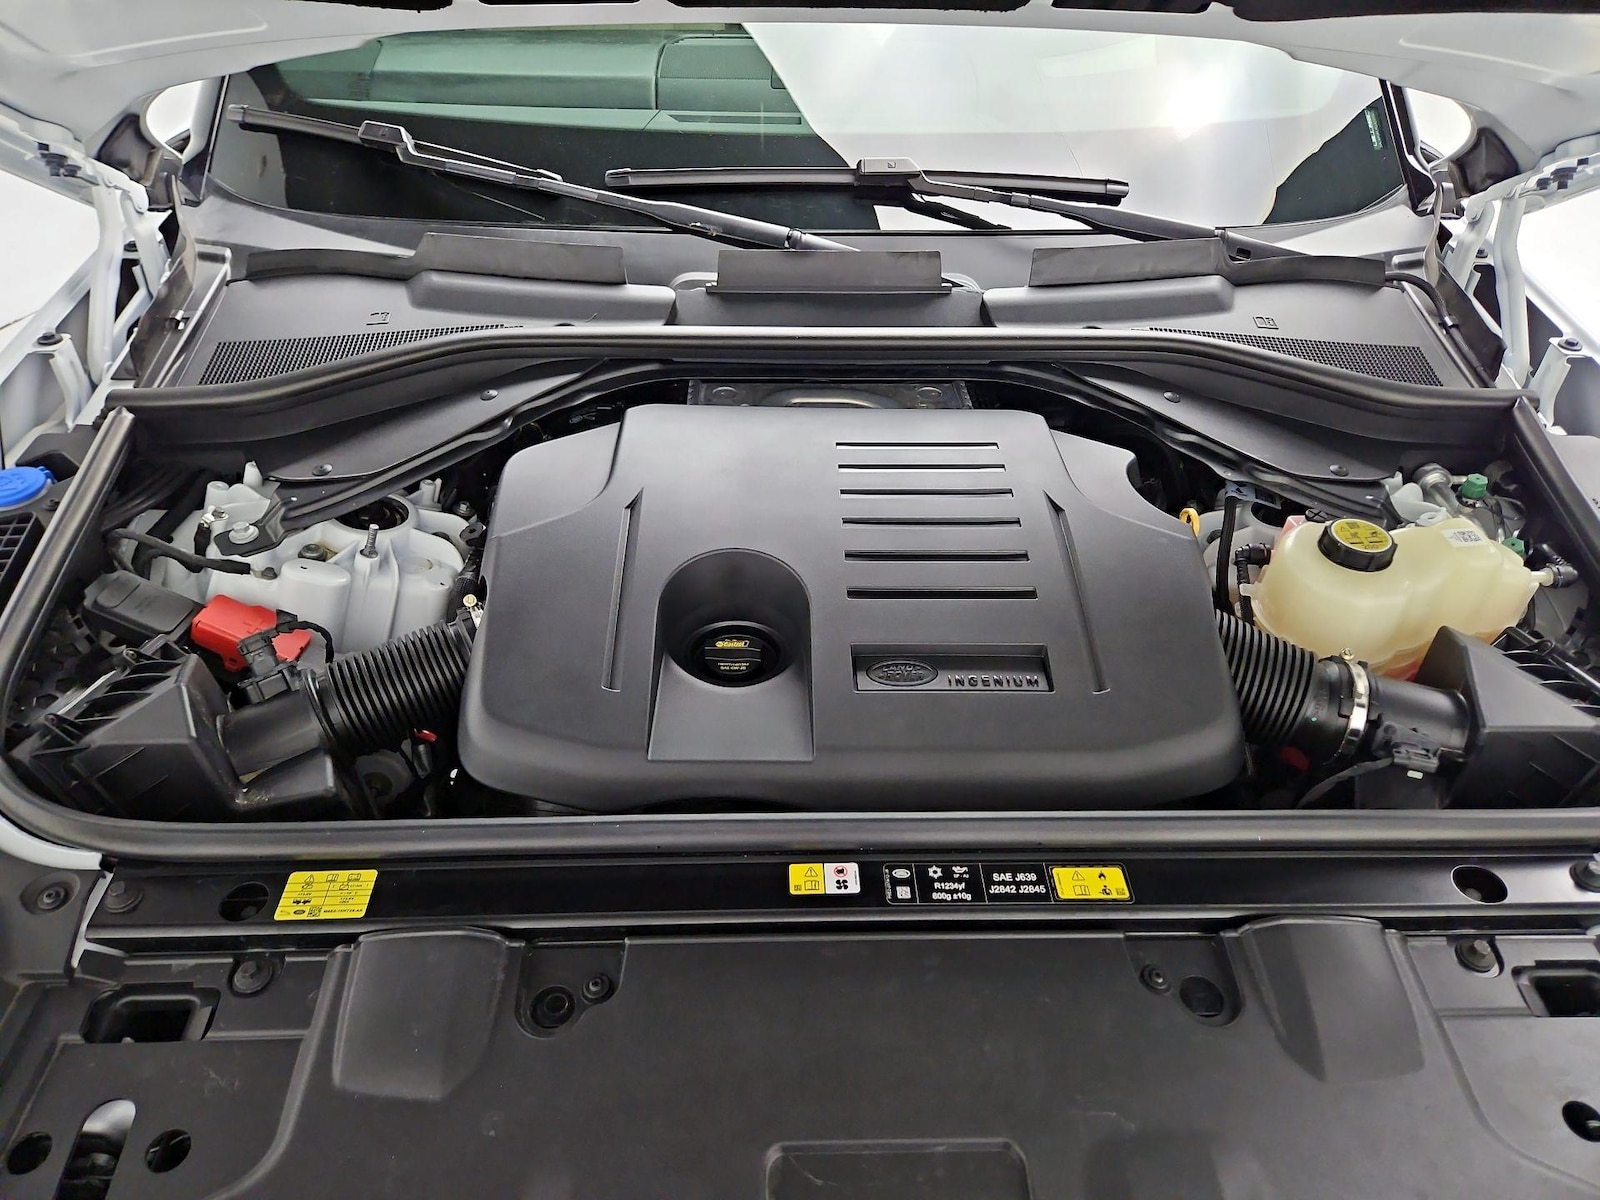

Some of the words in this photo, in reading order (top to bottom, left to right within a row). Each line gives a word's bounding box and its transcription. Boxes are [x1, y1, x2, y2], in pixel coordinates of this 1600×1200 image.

[947, 674, 1040, 688] INGENIUM
[992, 872, 1013, 882] SAE
[1014, 872, 1037, 882] J639
[934, 882, 965, 890] R1234yf
[989, 884, 1017, 894] J2842
[1018, 884, 1046, 894] J2845
